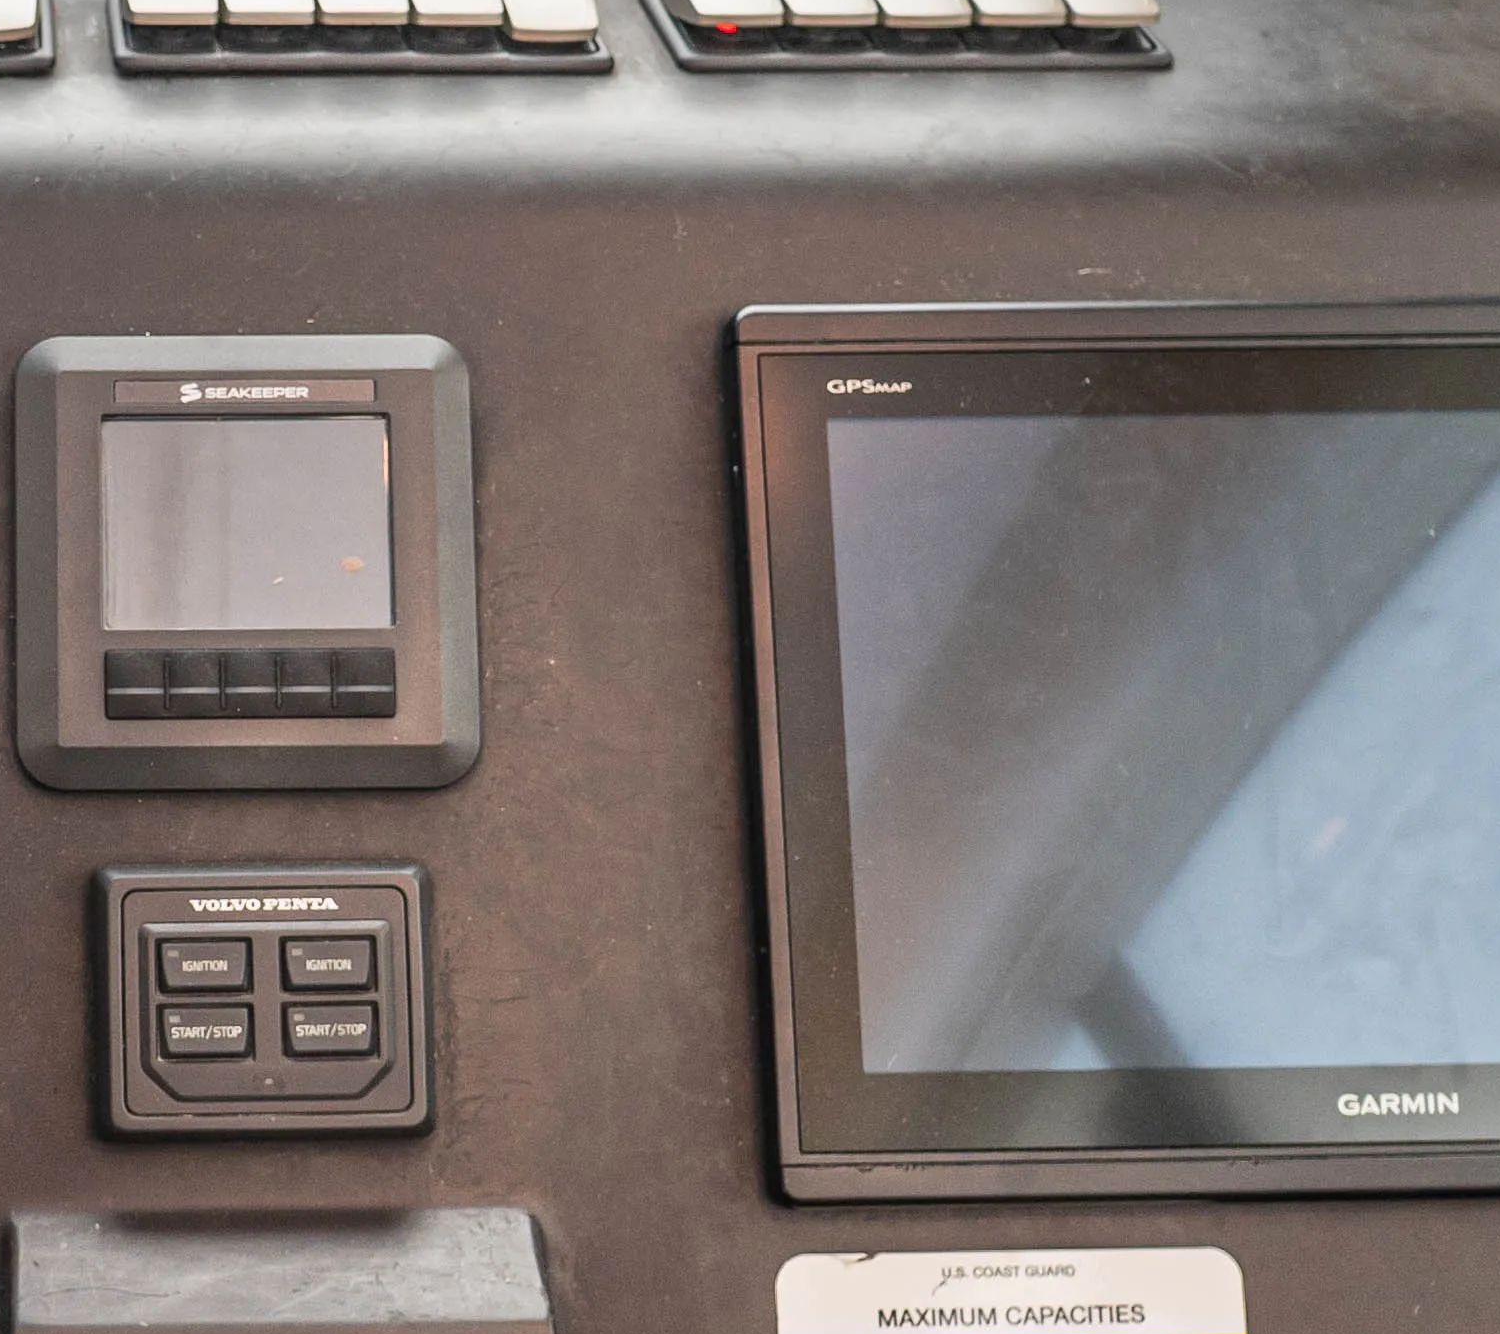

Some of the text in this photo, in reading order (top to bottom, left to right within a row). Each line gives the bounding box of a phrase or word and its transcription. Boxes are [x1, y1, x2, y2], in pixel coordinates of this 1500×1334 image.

[205, 387, 309, 399] SEAKEEPER
[189, 897, 338, 912] VOLVO PENTA
[182, 959, 228, 972] IGNITION
[306, 959, 352, 971] IGNITION
[170, 1025, 242, 1040] START/STOP
[296, 1023, 367, 1038] START/STOP
[1336, 1092, 1461, 1117] GARMIN
[941, 1265, 1076, 1278] U.S. COAST GUARD
[877, 1304, 1146, 1328] MAXIMUM CAPACITIES
